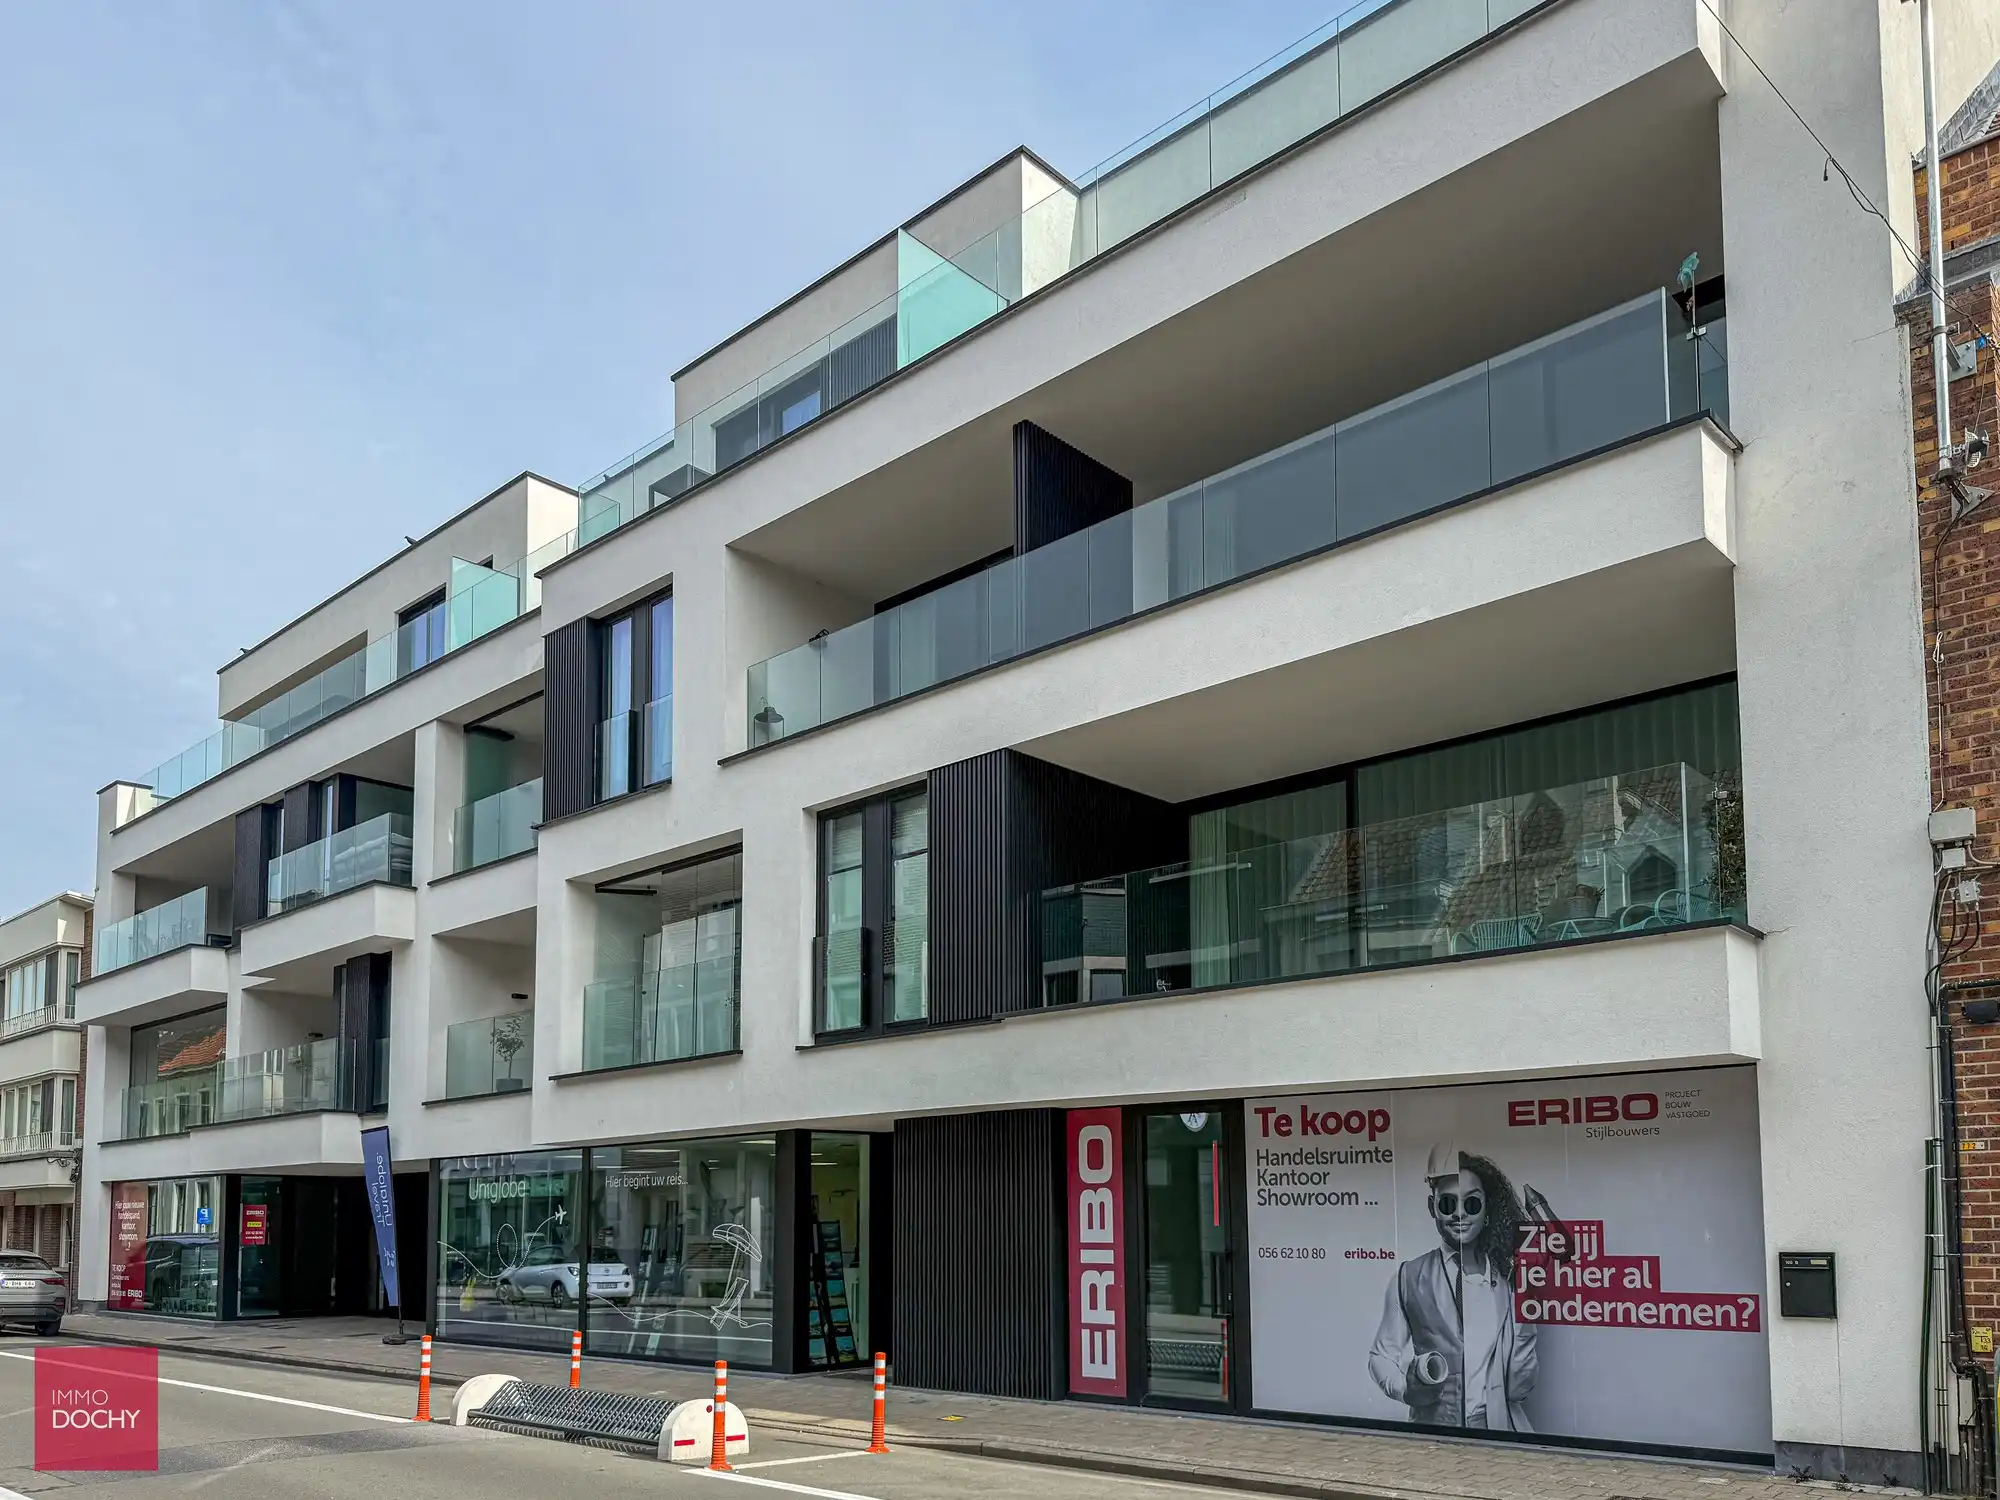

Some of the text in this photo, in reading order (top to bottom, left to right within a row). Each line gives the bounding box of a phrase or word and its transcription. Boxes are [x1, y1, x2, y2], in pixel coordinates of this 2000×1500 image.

[1664, 1089, 1702, 1099] PROJECT
[1507, 1093, 1659, 1127] ERIBO
[1665, 1101, 1692, 1109] BOUW
[1665, 1109, 1711, 1119] VASTGOED
[1254, 1104, 1391, 1142] Te koop
[1585, 1125, 1660, 1141] Stijlbouwers
[1256, 1146, 1394, 1167] Handelsruimte
[605, 1175, 622, 1188] Hier
[623, 1173, 650, 1189] begint
[651, 1176, 665, 1187] uw
[1256, 1168, 1331, 1187] Kantoor
[1256, 1187, 1360, 1206] Showroom
[1078, 1124, 1117, 1380] ERIBO
[1518, 1225, 1598, 1261] Zie jij
[1258, 1248, 1396, 1260] 056 62 10 80 eribo.be
[1517, 1258, 1653, 1294] je hier al
[1520, 1293, 1756, 1329] ondernemen?
